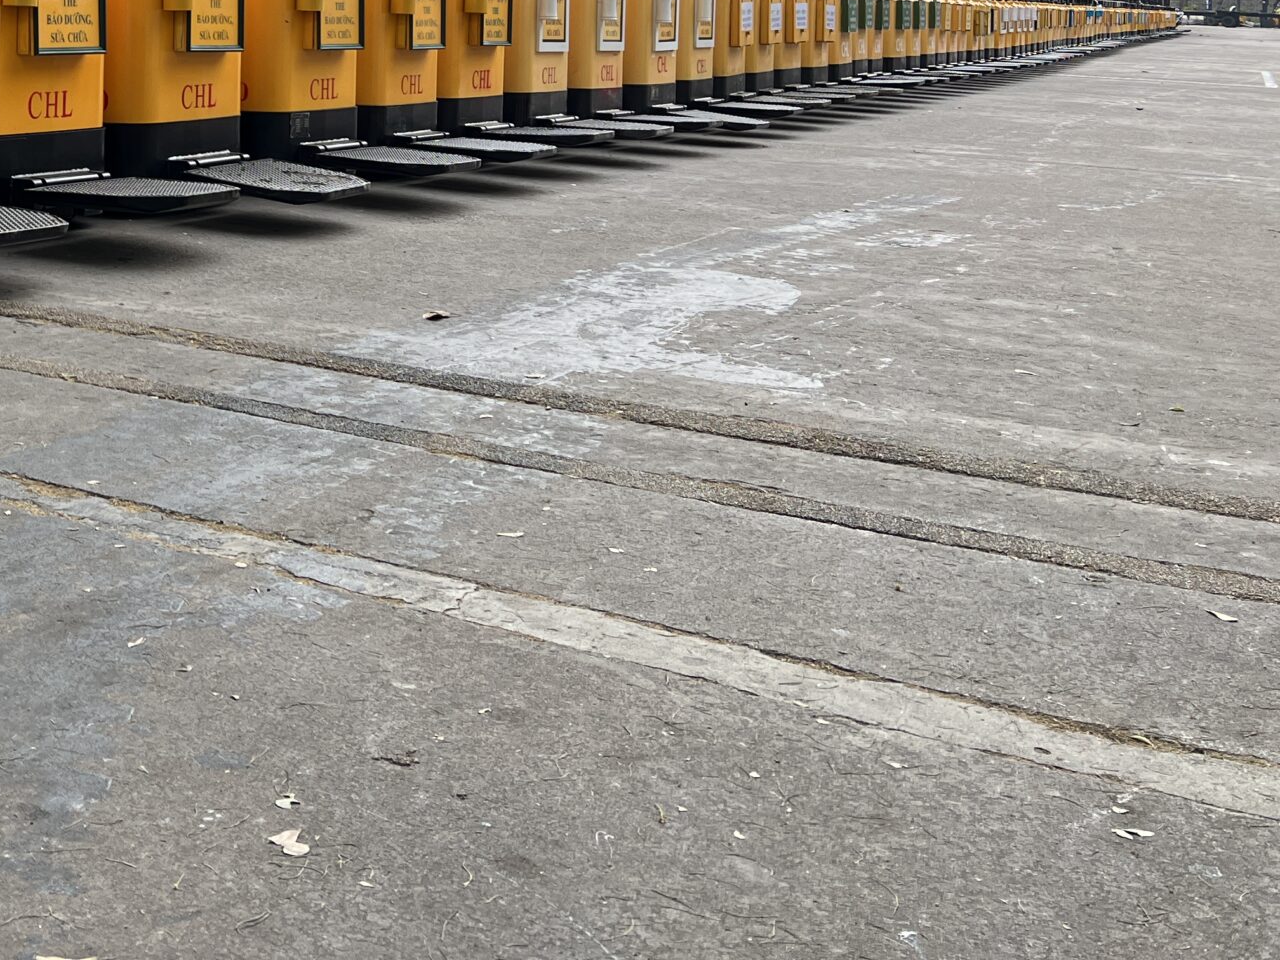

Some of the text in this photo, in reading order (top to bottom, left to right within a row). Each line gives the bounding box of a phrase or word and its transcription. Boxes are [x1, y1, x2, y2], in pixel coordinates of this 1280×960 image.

[472, 69, 492, 89] CHL
[541, 67, 557, 84] CHL
[600, 64, 615, 81] CHL
[310, 77, 338, 101] CHL
[401, 74, 424, 95] CHL
[27, 90, 73, 119] CHL
[181, 84, 217, 110] CHL
